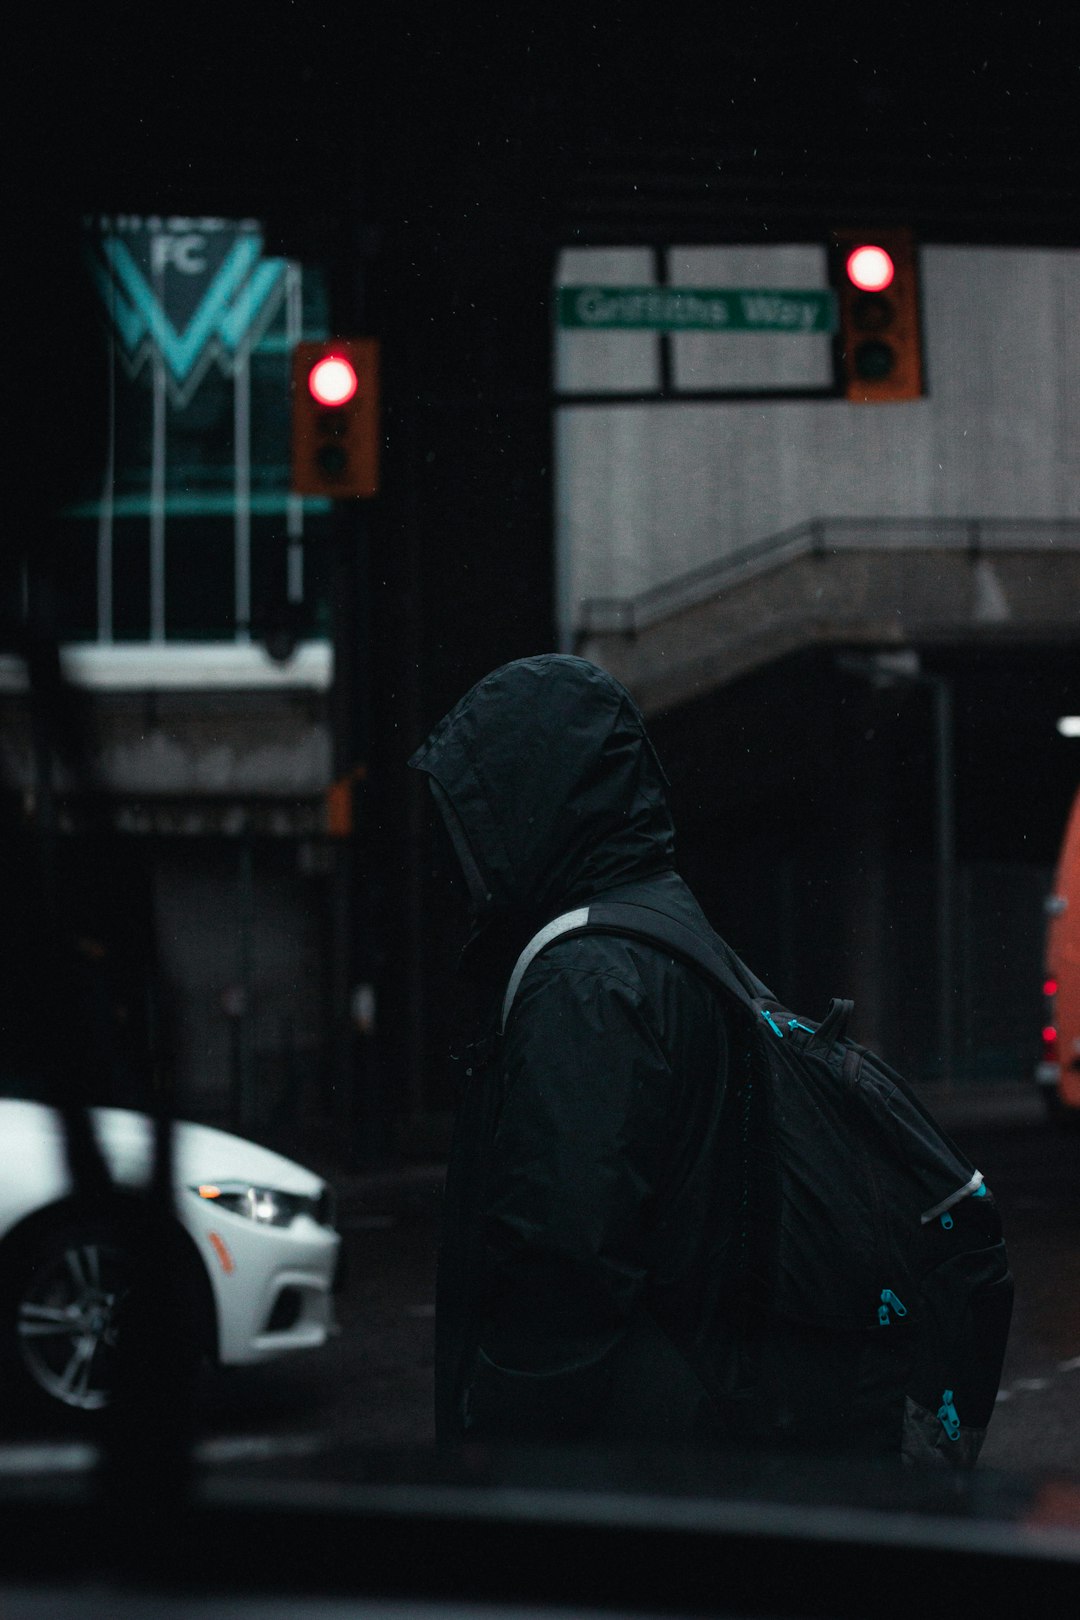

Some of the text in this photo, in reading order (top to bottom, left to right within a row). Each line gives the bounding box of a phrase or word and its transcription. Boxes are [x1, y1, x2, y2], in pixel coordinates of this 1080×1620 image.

[149, 235, 207, 273] FC
[576, 289, 818, 332] Griffiths Way
